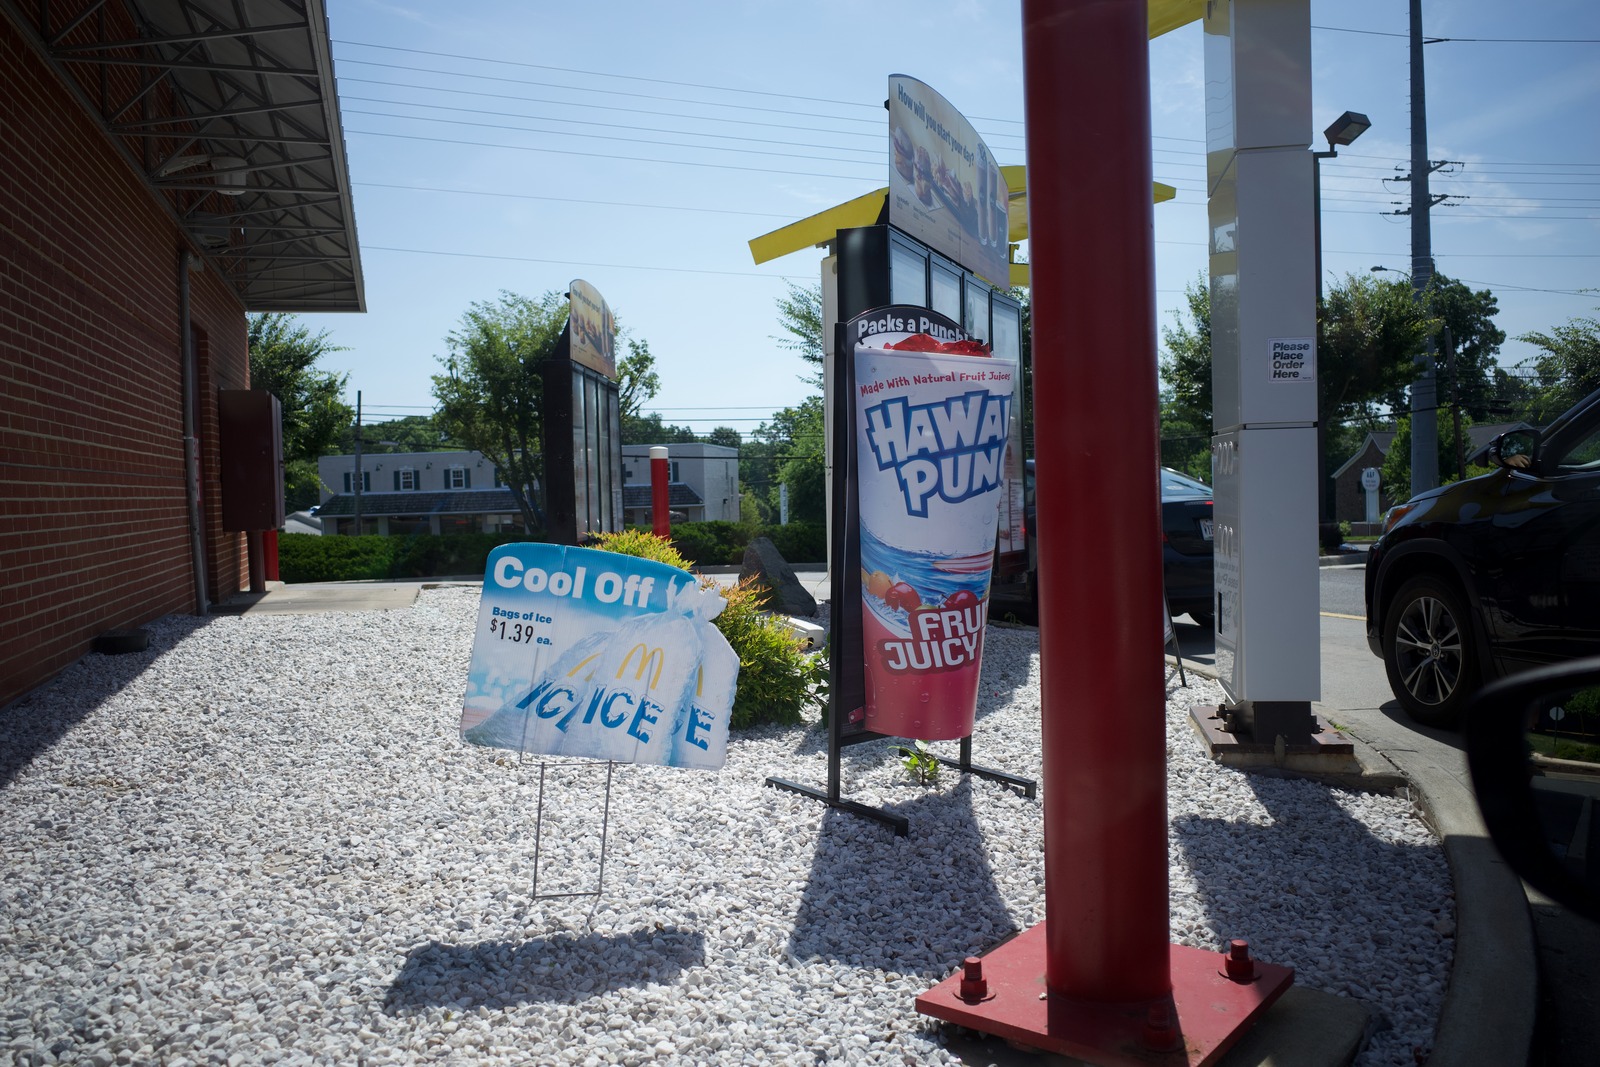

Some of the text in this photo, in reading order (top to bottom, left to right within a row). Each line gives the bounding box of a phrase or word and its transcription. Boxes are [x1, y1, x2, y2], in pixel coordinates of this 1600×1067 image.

[898, 83, 975, 168] How will you start your day?
[857, 313, 904, 339] Packs
[906, 318, 916, 333] a
[1272, 342, 1310, 352] Please
[1272, 351, 1304, 360] Place
[1272, 360, 1305, 370] Order
[1272, 369, 1300, 379] Here
[860, 371, 1011, 397] Made With Natural Fruit Juices
[493, 556, 655, 608] Cool Off
[492, 606, 553, 624] Bags of Ice
[917, 597, 989, 641] FRUI
[490, 618, 553, 646] $1.39 ea.
[884, 631, 978, 670] JUICY
[582, 683, 665, 744] ICE
